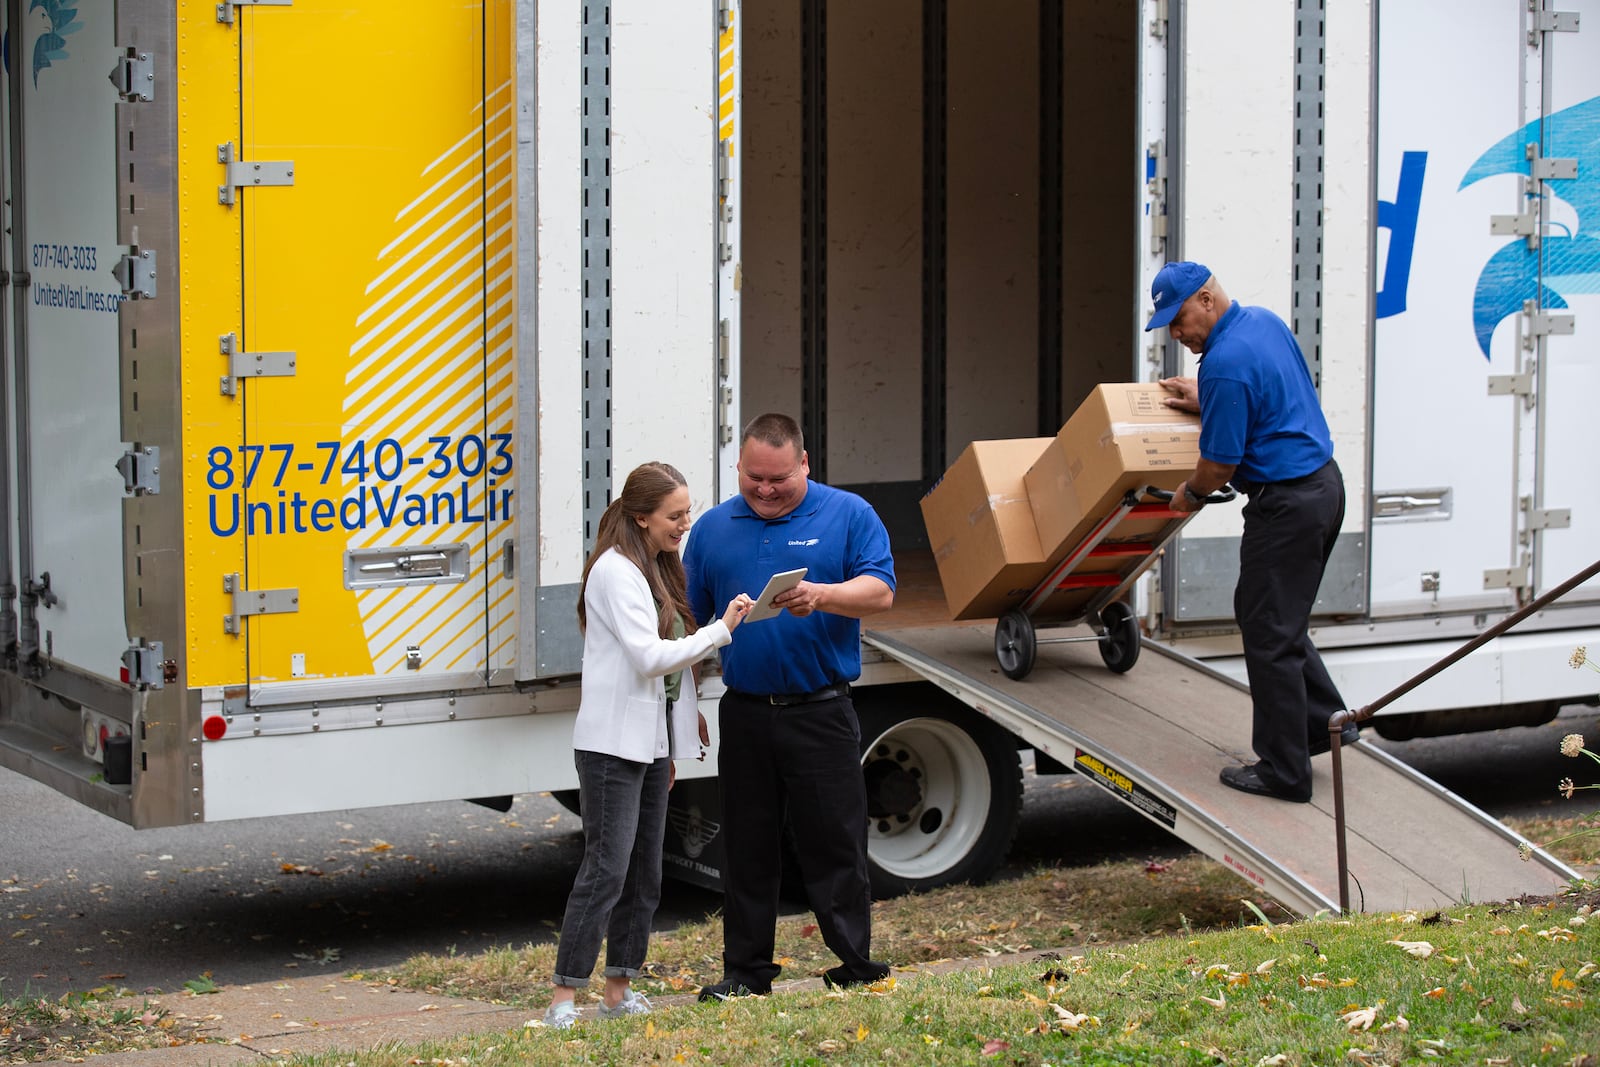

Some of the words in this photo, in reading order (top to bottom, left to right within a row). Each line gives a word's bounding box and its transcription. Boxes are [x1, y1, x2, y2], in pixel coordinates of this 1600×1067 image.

[33, 243, 97, 271] 877-740-3033
[206, 433, 513, 490] 877-740-303
[1086, 755, 1133, 793] MELCHER
[695, 862, 721, 878] TRAILER
